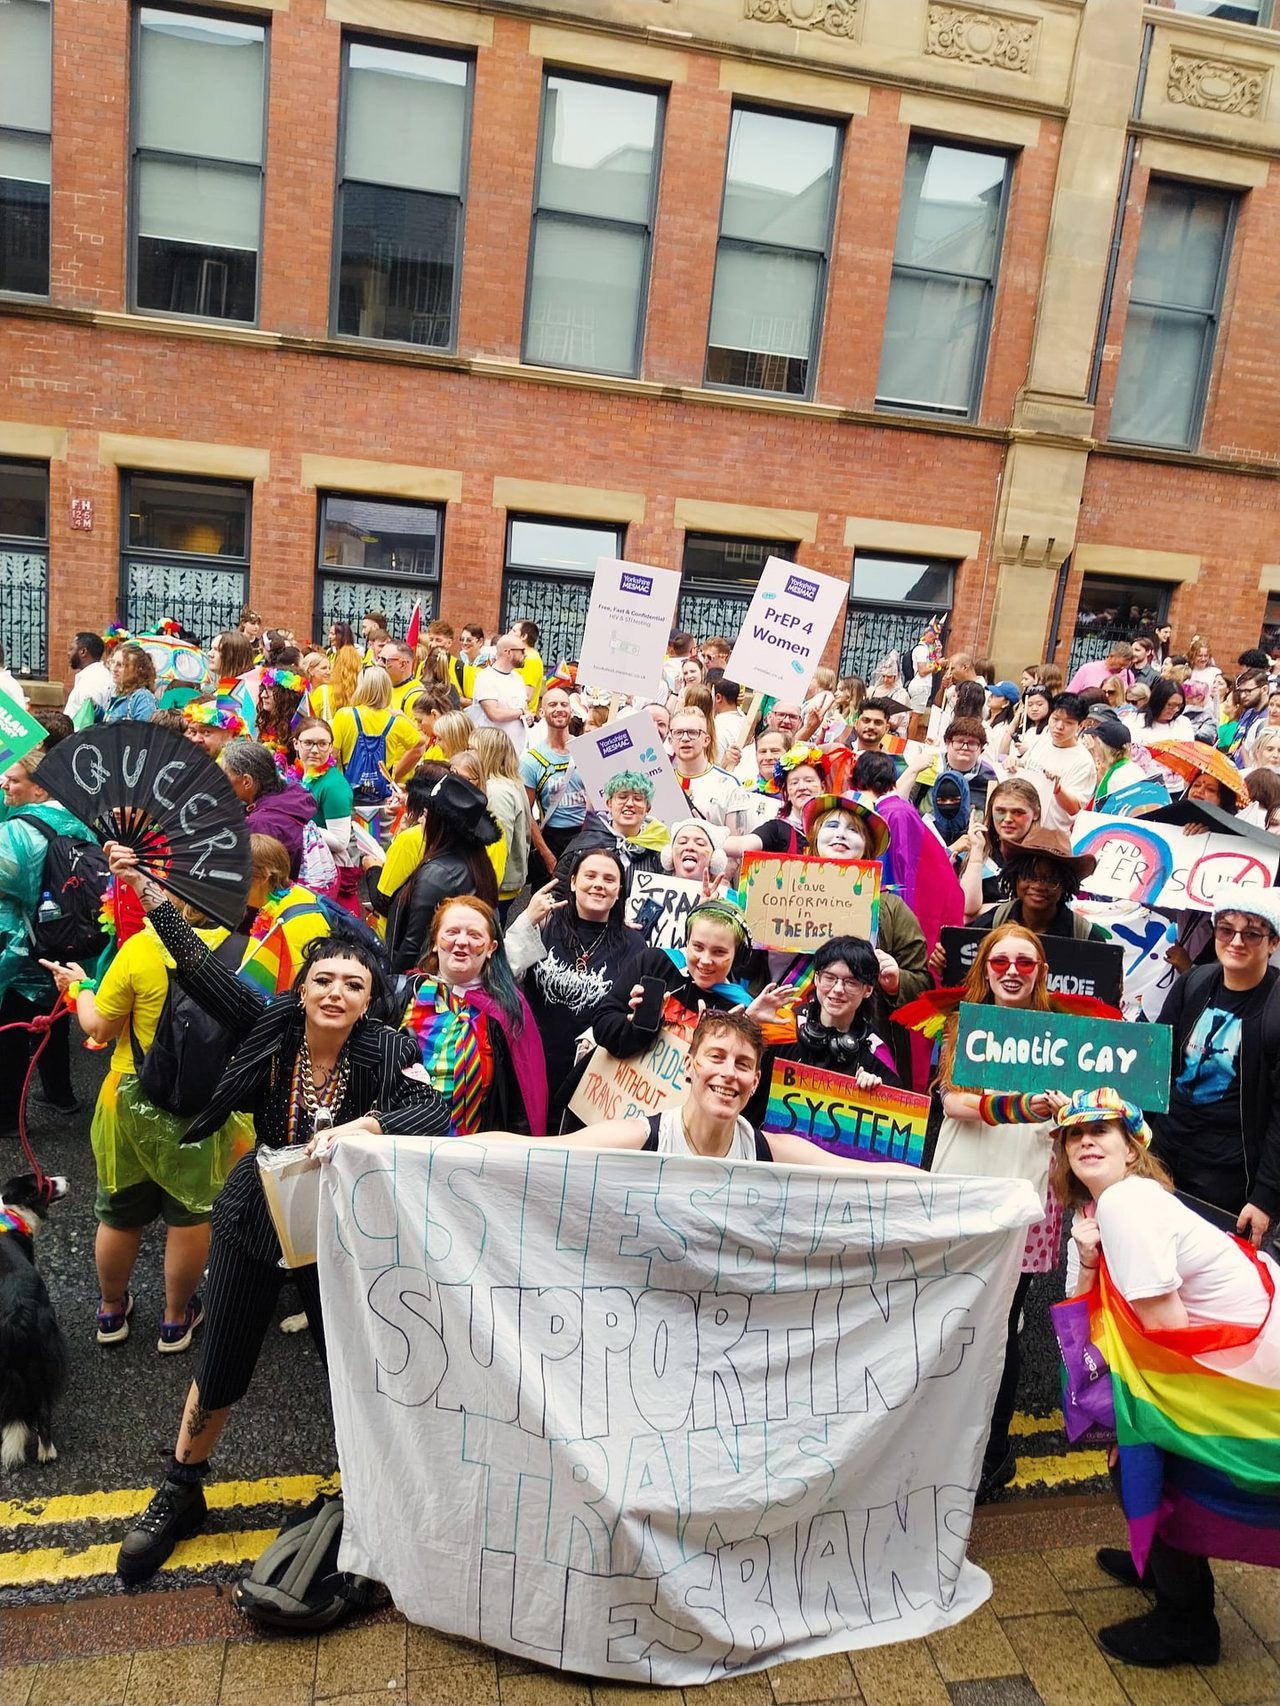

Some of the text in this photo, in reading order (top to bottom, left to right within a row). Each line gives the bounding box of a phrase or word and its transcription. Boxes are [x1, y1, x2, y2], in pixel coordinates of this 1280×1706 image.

[622, 581, 650, 592] MESMAC
[624, 575, 650, 585] Yorkshire
[791, 577, 817, 592] Yorkshire
[787, 585, 814, 599] MESMAC
[631, 610, 666, 622] Confidential
[764, 607, 814, 635] PrEP 4
[753, 625, 811, 657] Women
[599, 733, 628, 748] Yorkshire
[603, 739, 630, 755] MESMAC
[1101, 840, 1142, 858] END
[792, 878, 826, 893] Leave
[1077, 1042, 1137, 1074] GAY
[614, 1060, 667, 1110] WITHOUT
[783, 1065, 834, 1092] BREAK
[583, 1072, 623, 1120] TRANS
[781, 1092, 913, 1163] SYSTEM
[368, 1266, 986, 1440] SUPPORTING
[461, 1401, 836, 1577] TRANS
